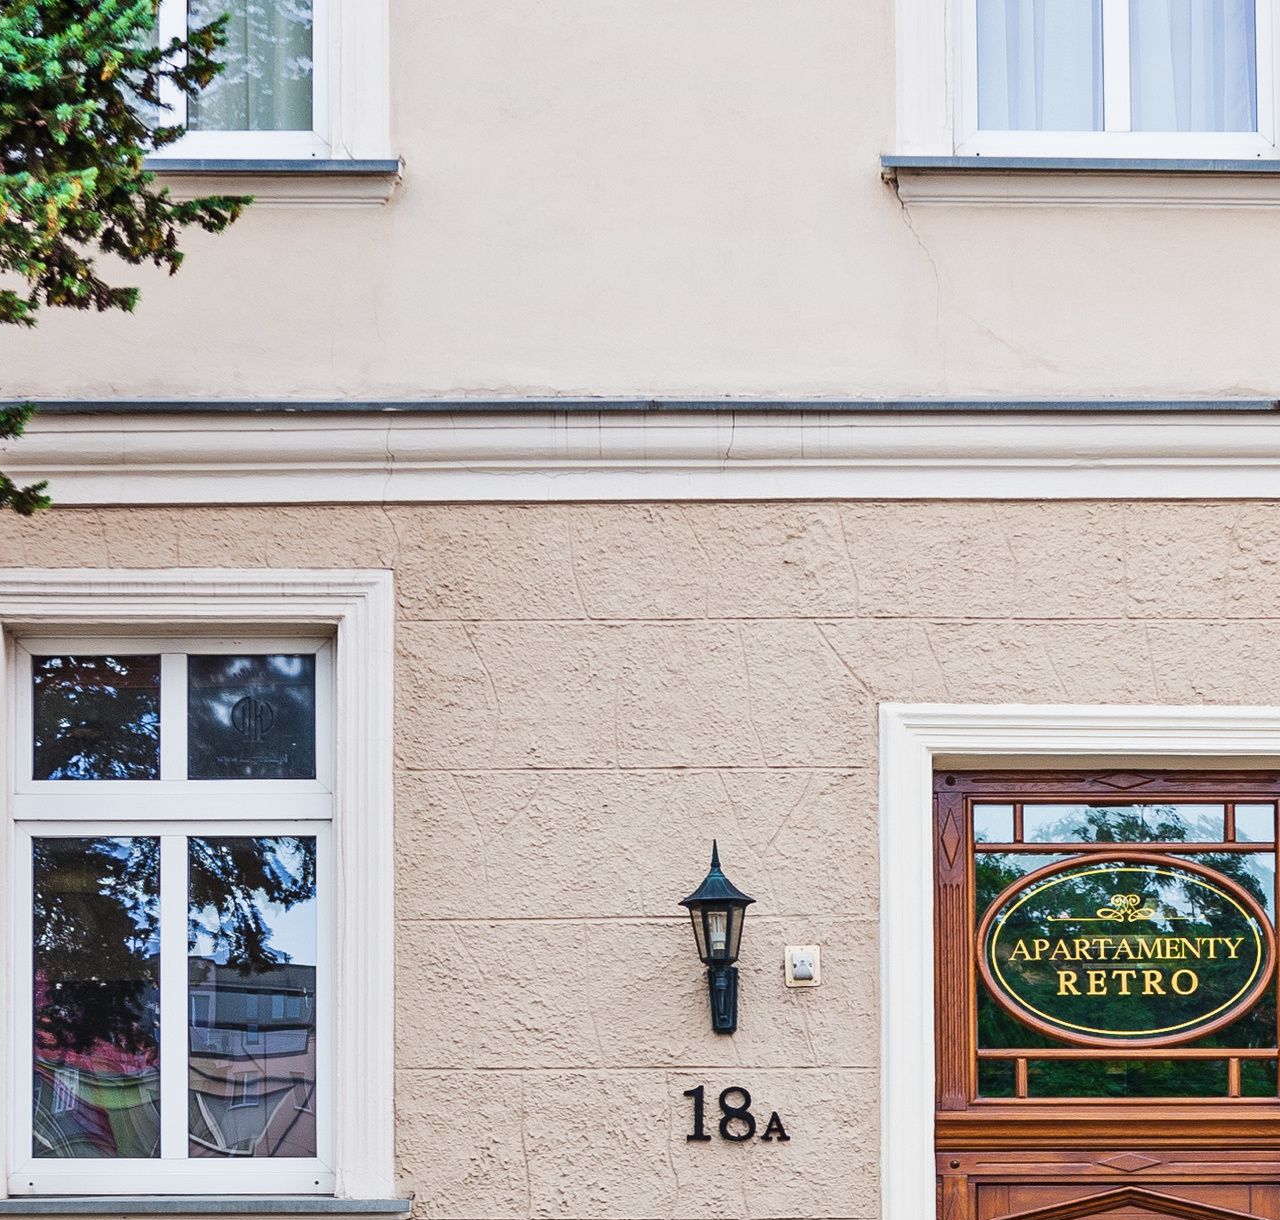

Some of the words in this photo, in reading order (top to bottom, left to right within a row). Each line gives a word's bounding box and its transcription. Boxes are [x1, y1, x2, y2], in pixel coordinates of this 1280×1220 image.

[1008, 937, 1246, 961] APARTAMENTY
[1056, 969, 1200, 997] RETRO
[682, 1085, 791, 1142] 18A
